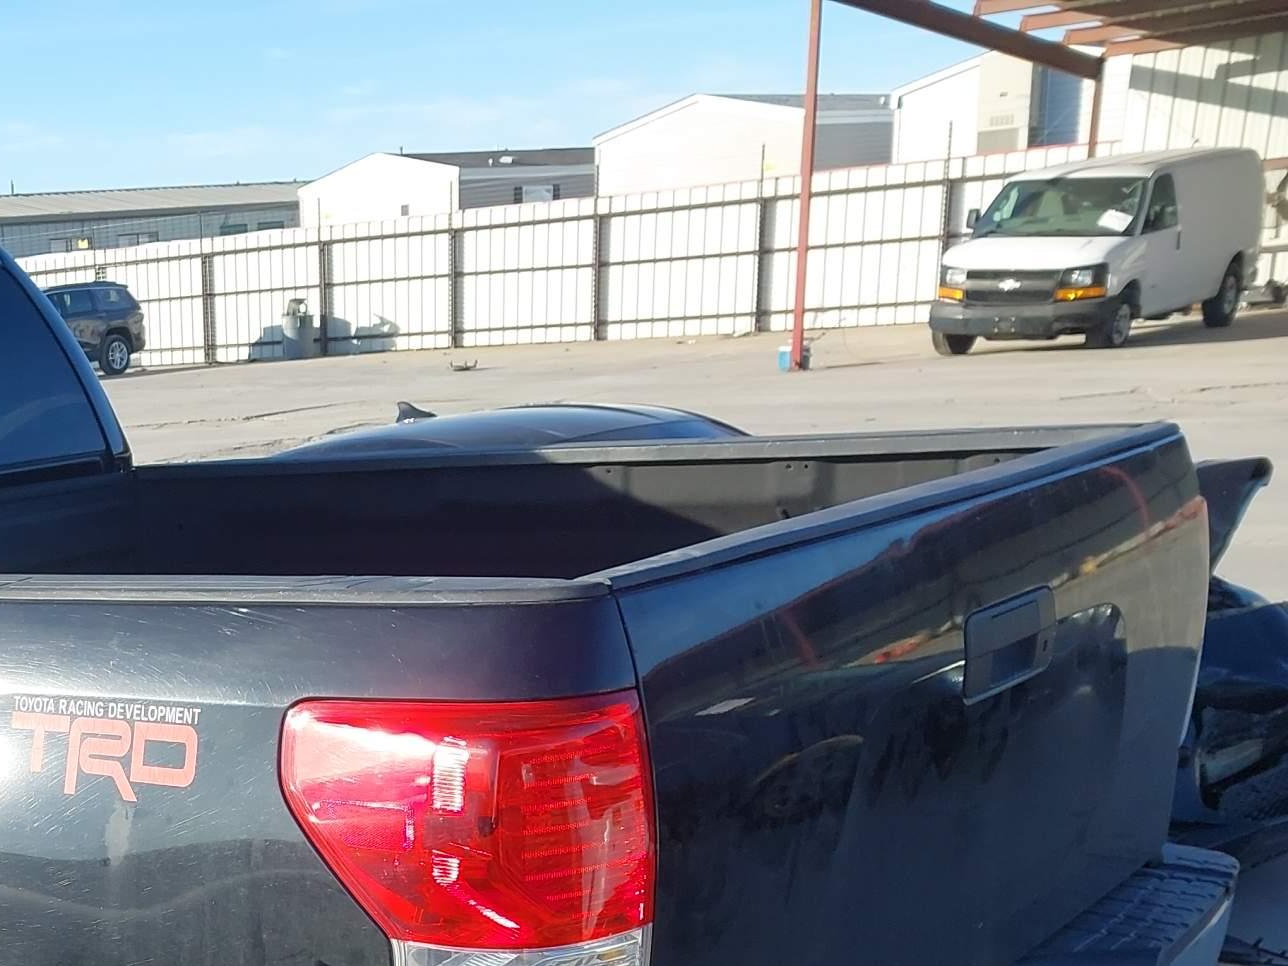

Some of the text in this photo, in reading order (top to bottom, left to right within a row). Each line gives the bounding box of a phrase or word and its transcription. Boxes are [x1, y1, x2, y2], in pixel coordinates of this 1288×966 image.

[13, 695, 201, 725] TOYOTA RACING DEVELOPMENT
[11, 711, 199, 802] TRD
